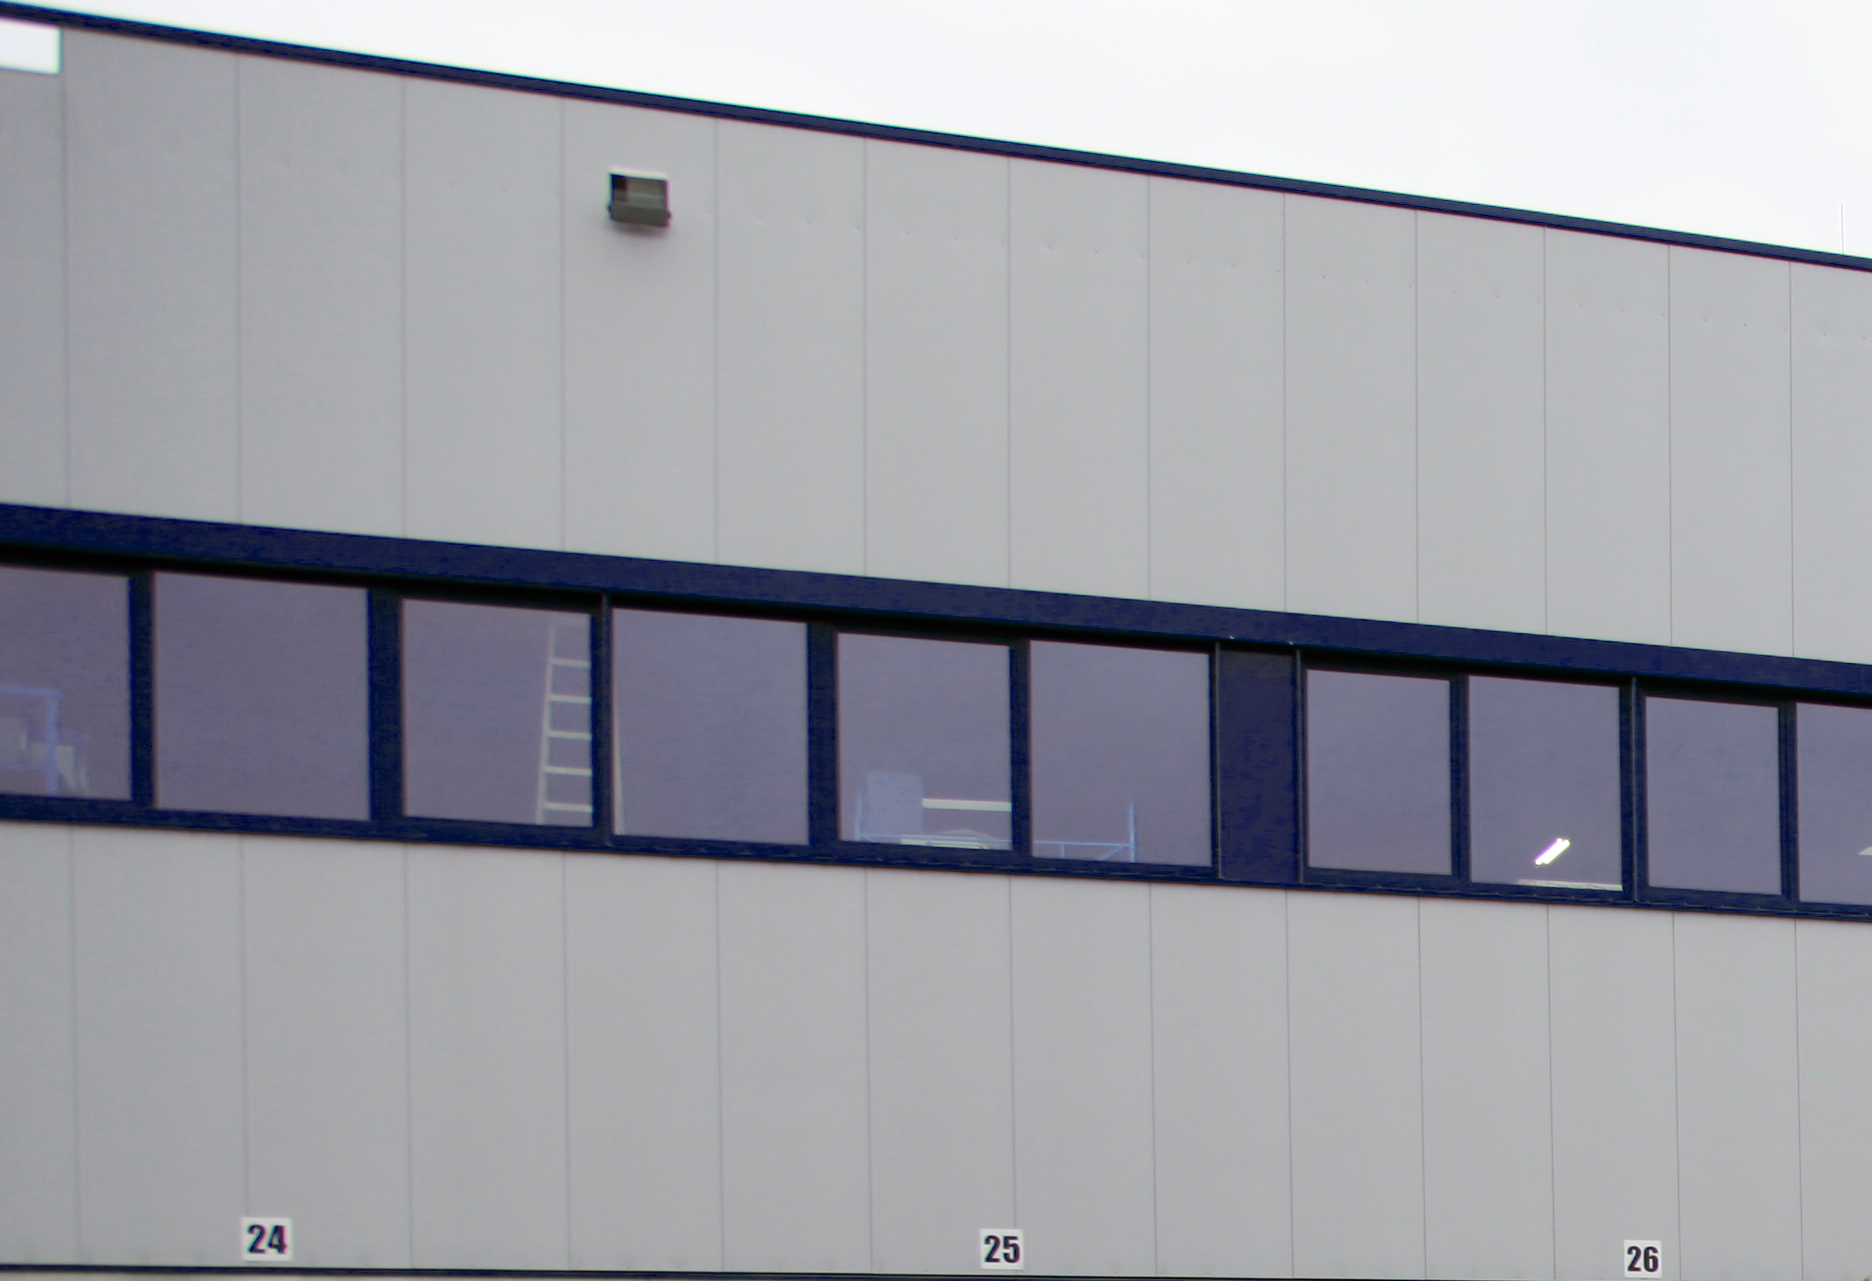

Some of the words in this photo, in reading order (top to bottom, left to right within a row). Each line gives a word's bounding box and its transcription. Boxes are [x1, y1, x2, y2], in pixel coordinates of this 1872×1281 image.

[248, 1224, 287, 1254] 24
[984, 1235, 1020, 1263] 25
[1627, 1246, 1659, 1272] 26
